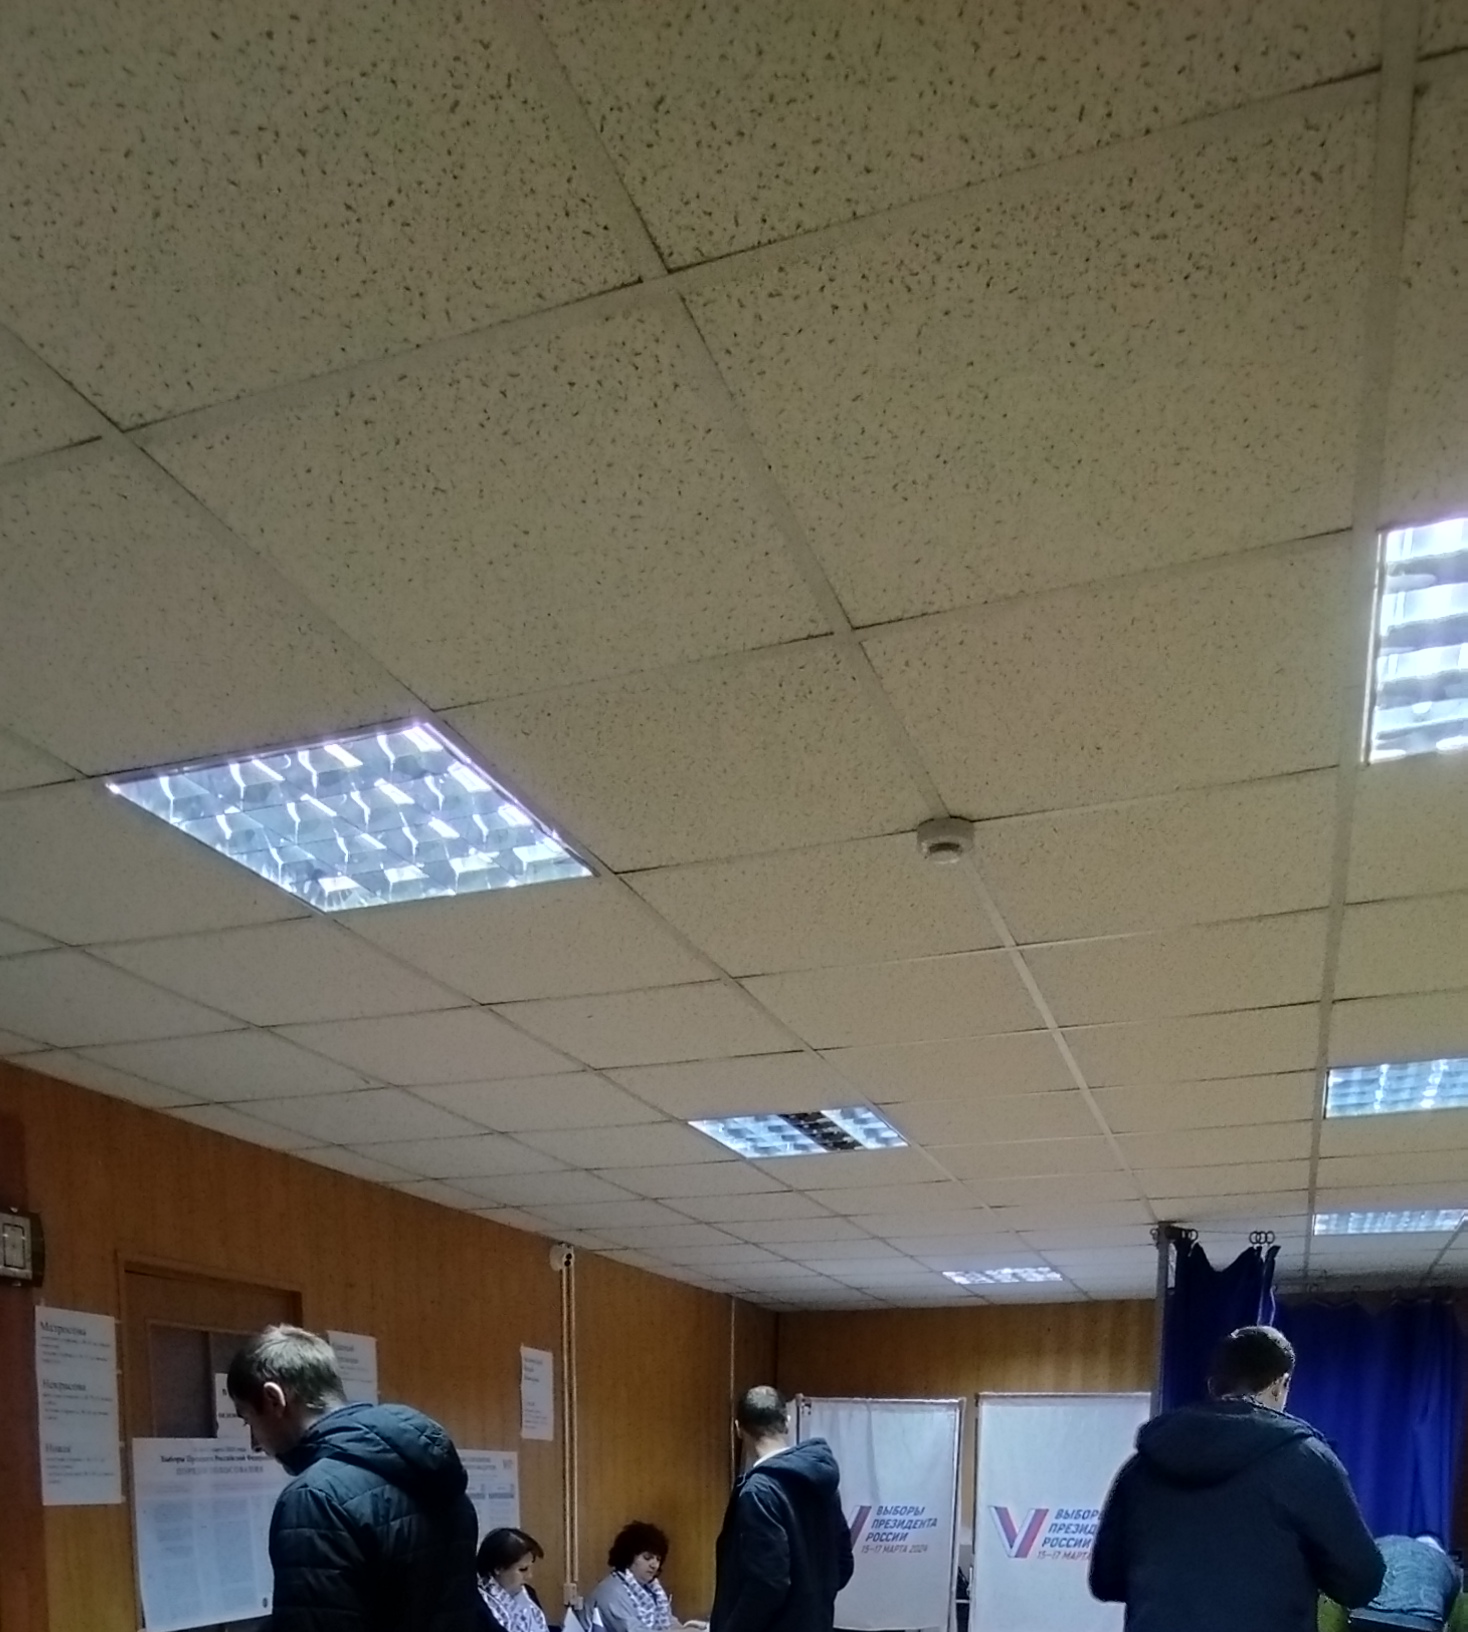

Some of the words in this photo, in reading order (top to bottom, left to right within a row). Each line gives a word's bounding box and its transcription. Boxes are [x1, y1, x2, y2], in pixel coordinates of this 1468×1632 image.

[876, 1505, 925, 1517] ВЫБОРЫ
[871, 1518, 938, 1530] ПРЕЗИДЕНТА
[1048, 1523, 1098, 1535] ПРЕЗИД
[865, 1532, 909, 1542] РОССИИ
[1042, 1537, 1092, 1548] РОССИИ
[882, 1544, 907, 1554] МАРТА
[908, 1544, 928, 1554] 2024
